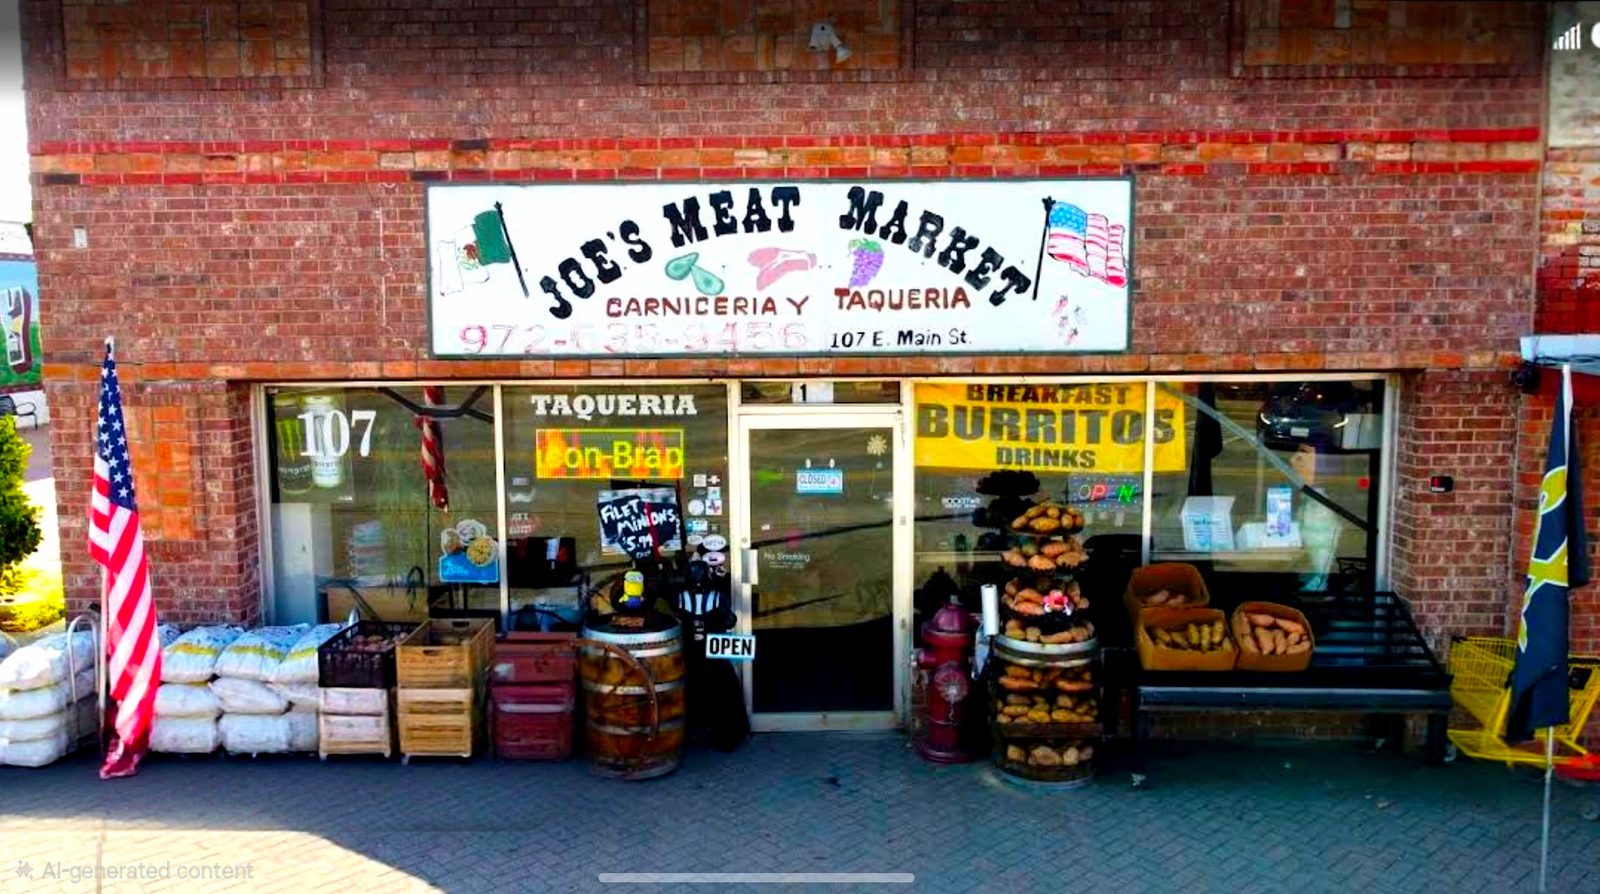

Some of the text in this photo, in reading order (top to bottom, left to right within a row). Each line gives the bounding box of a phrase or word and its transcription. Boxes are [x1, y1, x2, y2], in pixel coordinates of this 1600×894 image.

[539, 186, 1032, 319] JOE'S MEAT MARKET
[606, 287, 971, 317] CARNICERIA Y TAQUERIA
[831, 327, 972, 349] 107 E. Main St.
[967, 383, 1132, 404] BREAKFAST
[531, 394, 698, 421] TAQUERIA
[297, 410, 377, 458] 107
[917, 403, 1176, 445] BURRITOS
[996, 447, 1096, 468] DRINKS
[709, 637, 752, 656] OPEN
